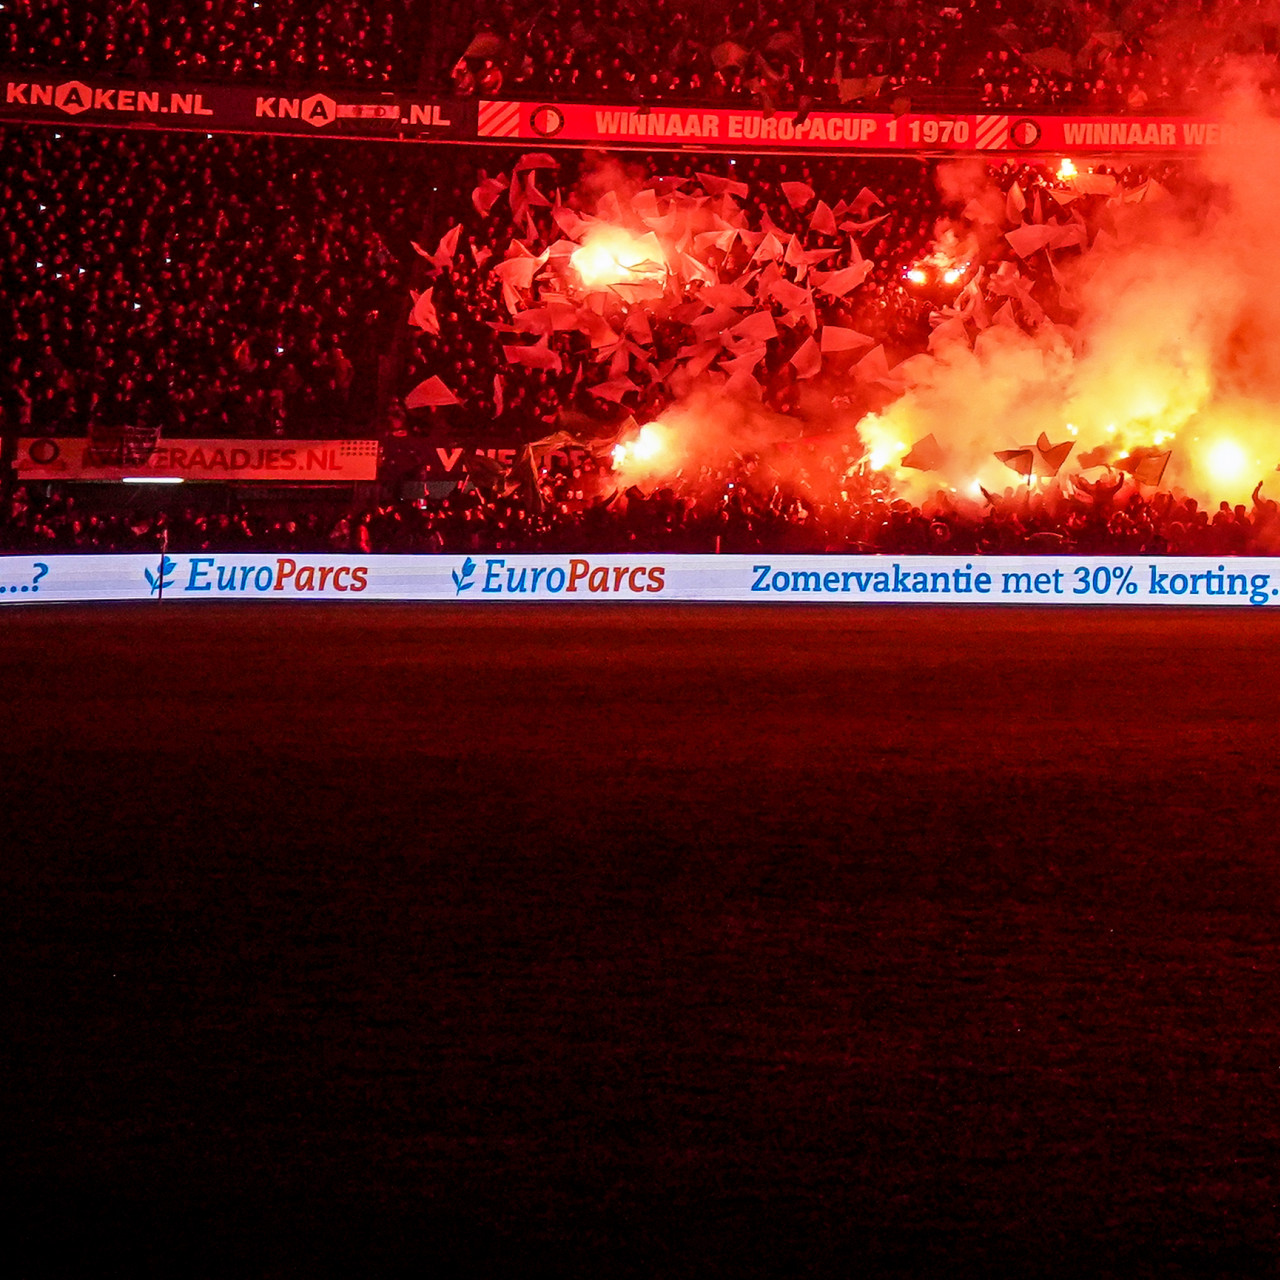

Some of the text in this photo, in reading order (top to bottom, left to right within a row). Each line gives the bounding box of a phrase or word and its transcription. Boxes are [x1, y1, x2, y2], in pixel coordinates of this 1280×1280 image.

[6, 81, 213, 116] KNAKEN.NL
[256, 94, 451, 126] KNA.NL
[595, 111, 969, 143] WINNAAR EUROPACUP 1 1970
[1063, 123, 1176, 145] WINNAAR
[185, 558, 368, 593] EuroParcs
[481, 558, 665, 594] EuroParcs
[751, 564, 991, 594] Zomervakantie
[1002, 569, 1063, 594] met
[1073, 566, 1138, 594] 30%
